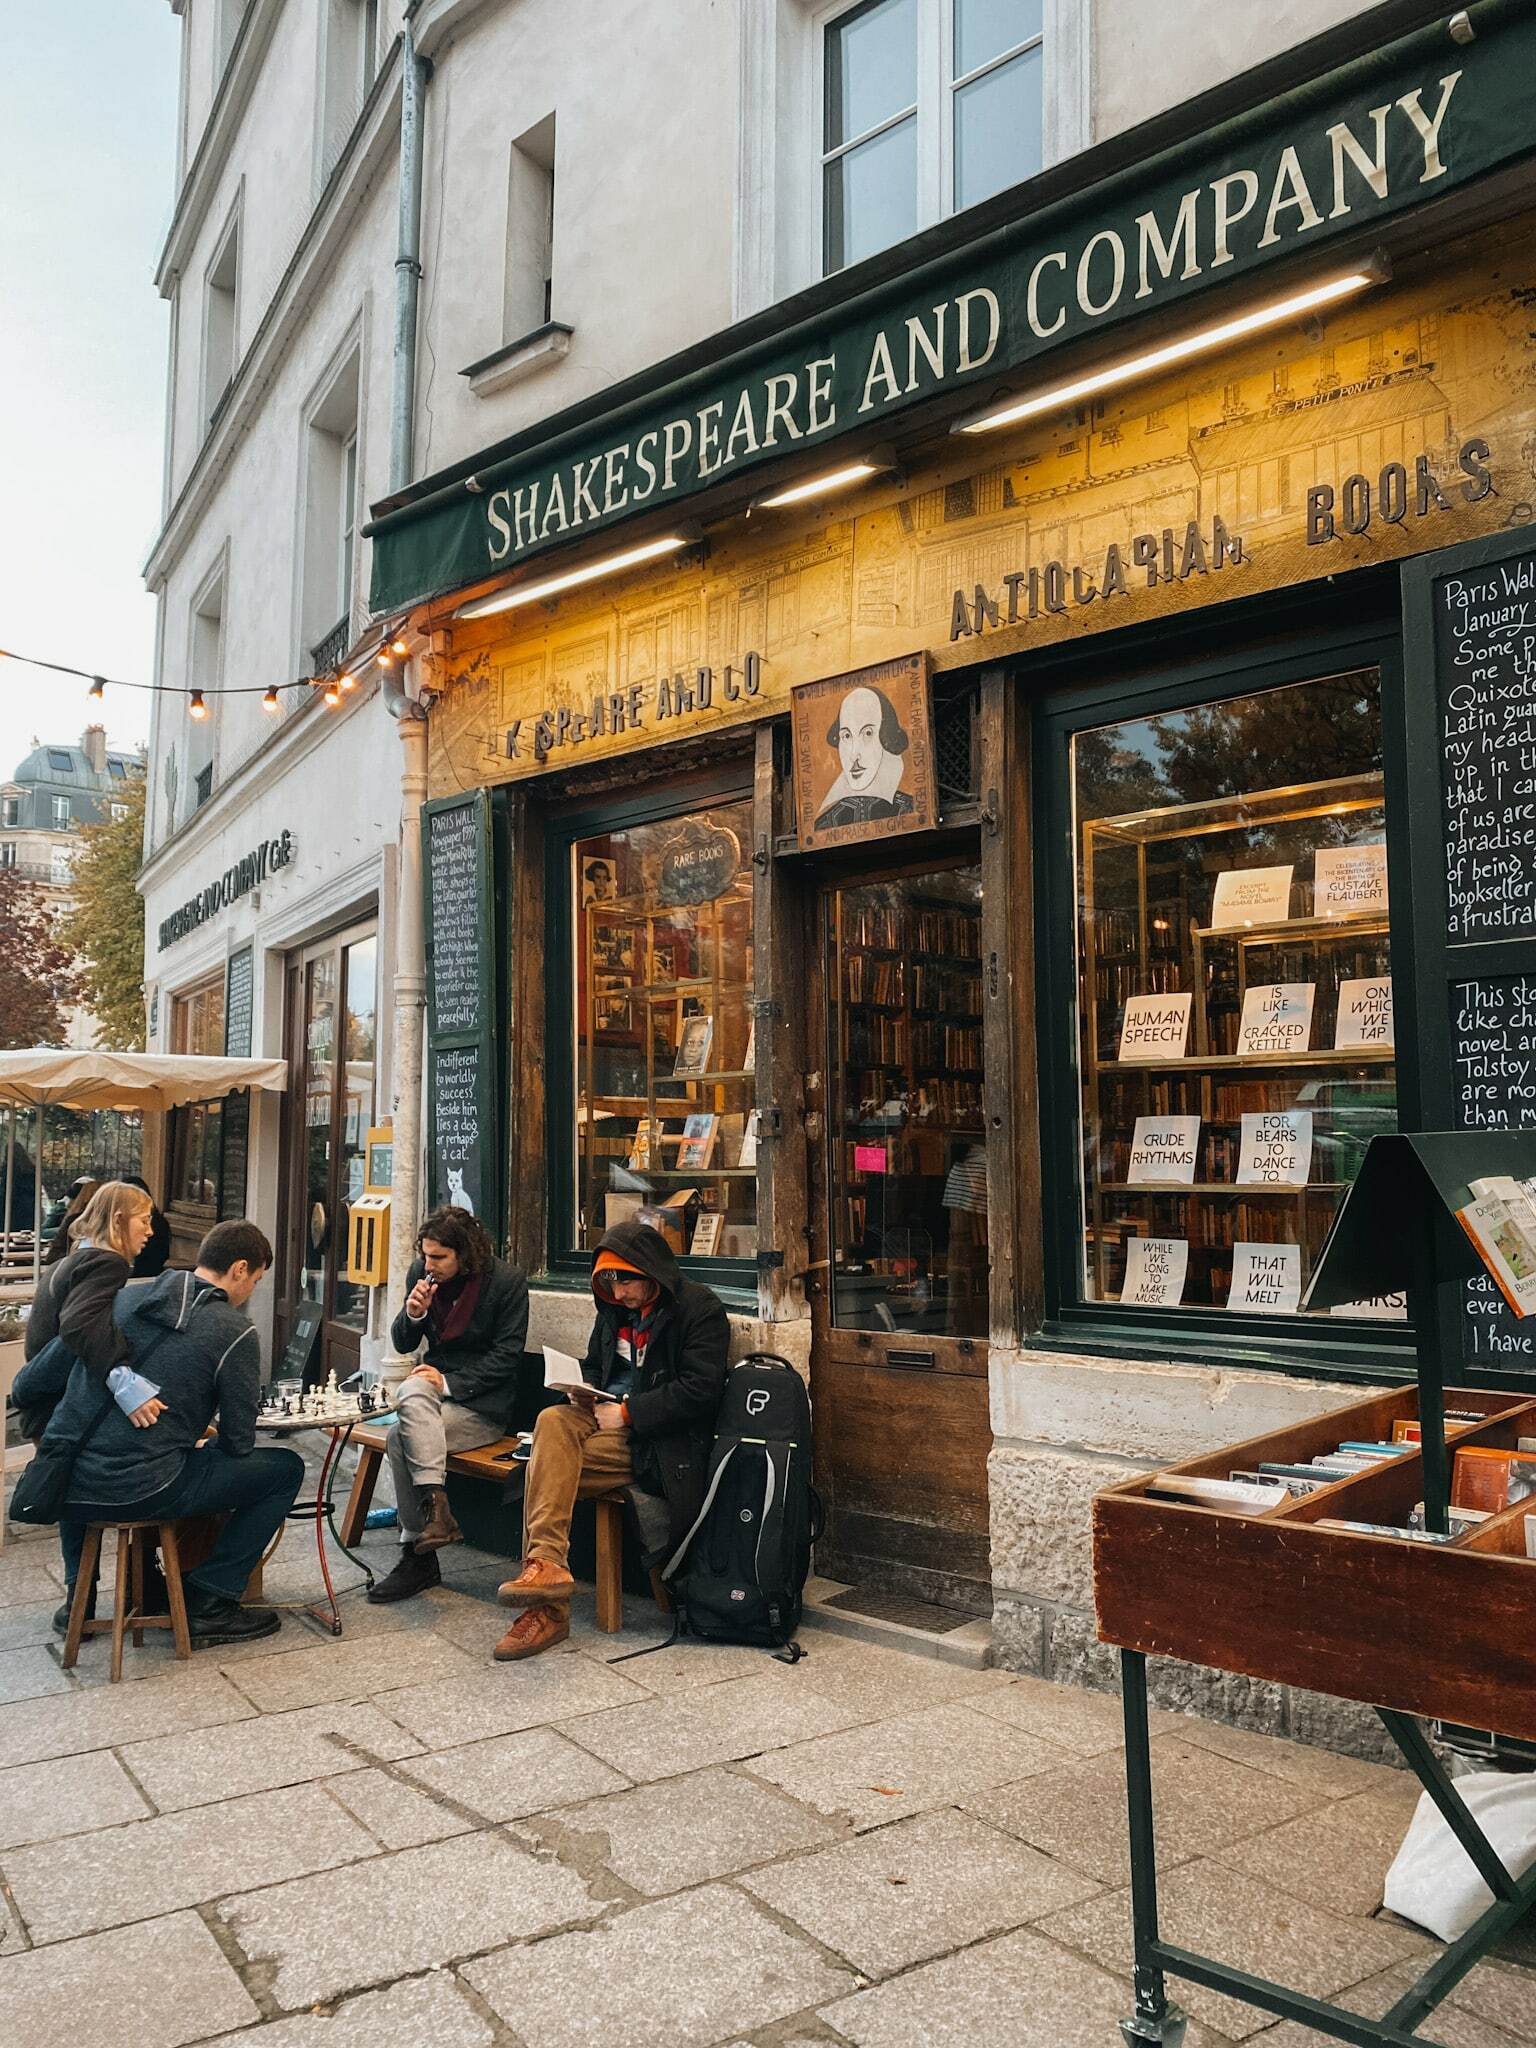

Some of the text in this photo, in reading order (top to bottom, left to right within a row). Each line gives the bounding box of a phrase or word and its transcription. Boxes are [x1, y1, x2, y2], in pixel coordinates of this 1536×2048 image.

[486, 70, 1463, 563] SHAKESPEARE AND COMPANY
[1306, 438, 1491, 546] BOOKS
[1444, 580, 1498, 611] Paris
[1453, 602, 1529, 637] January
[1454, 639, 1514, 665] Some
[1472, 666, 1499, 683] me
[656, 666, 712, 720] AND
[1445, 708, 1497, 739] Latin
[1445, 721, 1536, 766] my head
[1455, 756, 1510, 788] up in
[1446, 776, 1502, 809] that I
[431, 808, 476, 833] PARIS WALL
[1448, 803, 1536, 840] of us are
[673, 845, 724, 869] RARE BOOKS
[449, 861, 465, 875] about
[467, 860, 477, 872] the
[1447, 854, 1524, 887] of being
[450, 876, 469, 889] shops
[469, 873, 477, 889] of
[1329, 879, 1382, 892] GUSTAVE
[432, 891, 442, 904] the
[1326, 888, 1384, 902] FLAUBERT
[1449, 877, 1534, 908] bookseller
[462, 900, 478, 913] shop
[460, 912, 478, 928] filled
[1448, 914, 1459, 933] a
[446, 927, 456, 938] old
[457, 925, 475, 939] books
[455, 952, 478, 966] seemed
[441, 967, 459, 980] enter
[466, 966, 478, 978] the
[435, 980, 464, 997] proprietor
[1271, 986, 1282, 998] IS
[1366, 986, 1389, 999] ON
[1456, 981, 1504, 1010] This
[444, 997, 459, 1008] seen
[1263, 1000, 1289, 1012] LIKE
[437, 1006, 478, 1028] peacefully,
[1126, 1010, 1185, 1028] HUMAN
[1269, 1013, 1278, 1024] A
[1363, 1013, 1389, 1026] WE
[1456, 1009, 1503, 1031] like
[1124, 1027, 1183, 1044] SPEECH
[1244, 1025, 1304, 1040] CRACKED
[1360, 1026, 1386, 1040] TAP
[1248, 1038, 1291, 1051] KETTLE
[1458, 1031, 1513, 1054] novel
[437, 1048, 479, 1070] indifferent
[1456, 1053, 1530, 1085] Tolstoy
[436, 1068, 477, 1088] to worldly
[1462, 1084, 1498, 1100] are
[435, 1100, 478, 1117] Beside him
[1464, 1103, 1509, 1125] than
[436, 1117, 479, 1139] lies a dog
[1263, 1116, 1290, 1129] FOR
[436, 1131, 474, 1148] or perhaps
[1143, 1133, 1185, 1147] CRUDE
[1256, 1130, 1297, 1142] BEARS
[441, 1145, 470, 1160] a cat.
[1267, 1143, 1284, 1156] TO
[1132, 1151, 1194, 1165] RHYTHMS
[1253, 1157, 1296, 1169] DANCE
[1143, 1242, 1173, 1254] WHILE
[1149, 1253, 1166, 1264] WE
[1250, 1255, 1287, 1271] THAT
[1144, 1263, 1169, 1274] LONG
[1149, 1274, 1162, 1284] TO
[1248, 1273, 1285, 1288] WILL
[1140, 1283, 1168, 1294] MAKE
[1134, 1293, 1166, 1304] MUSIC
[1245, 1289, 1281, 1305] MELT
[1473, 1324, 1534, 1354] I have
